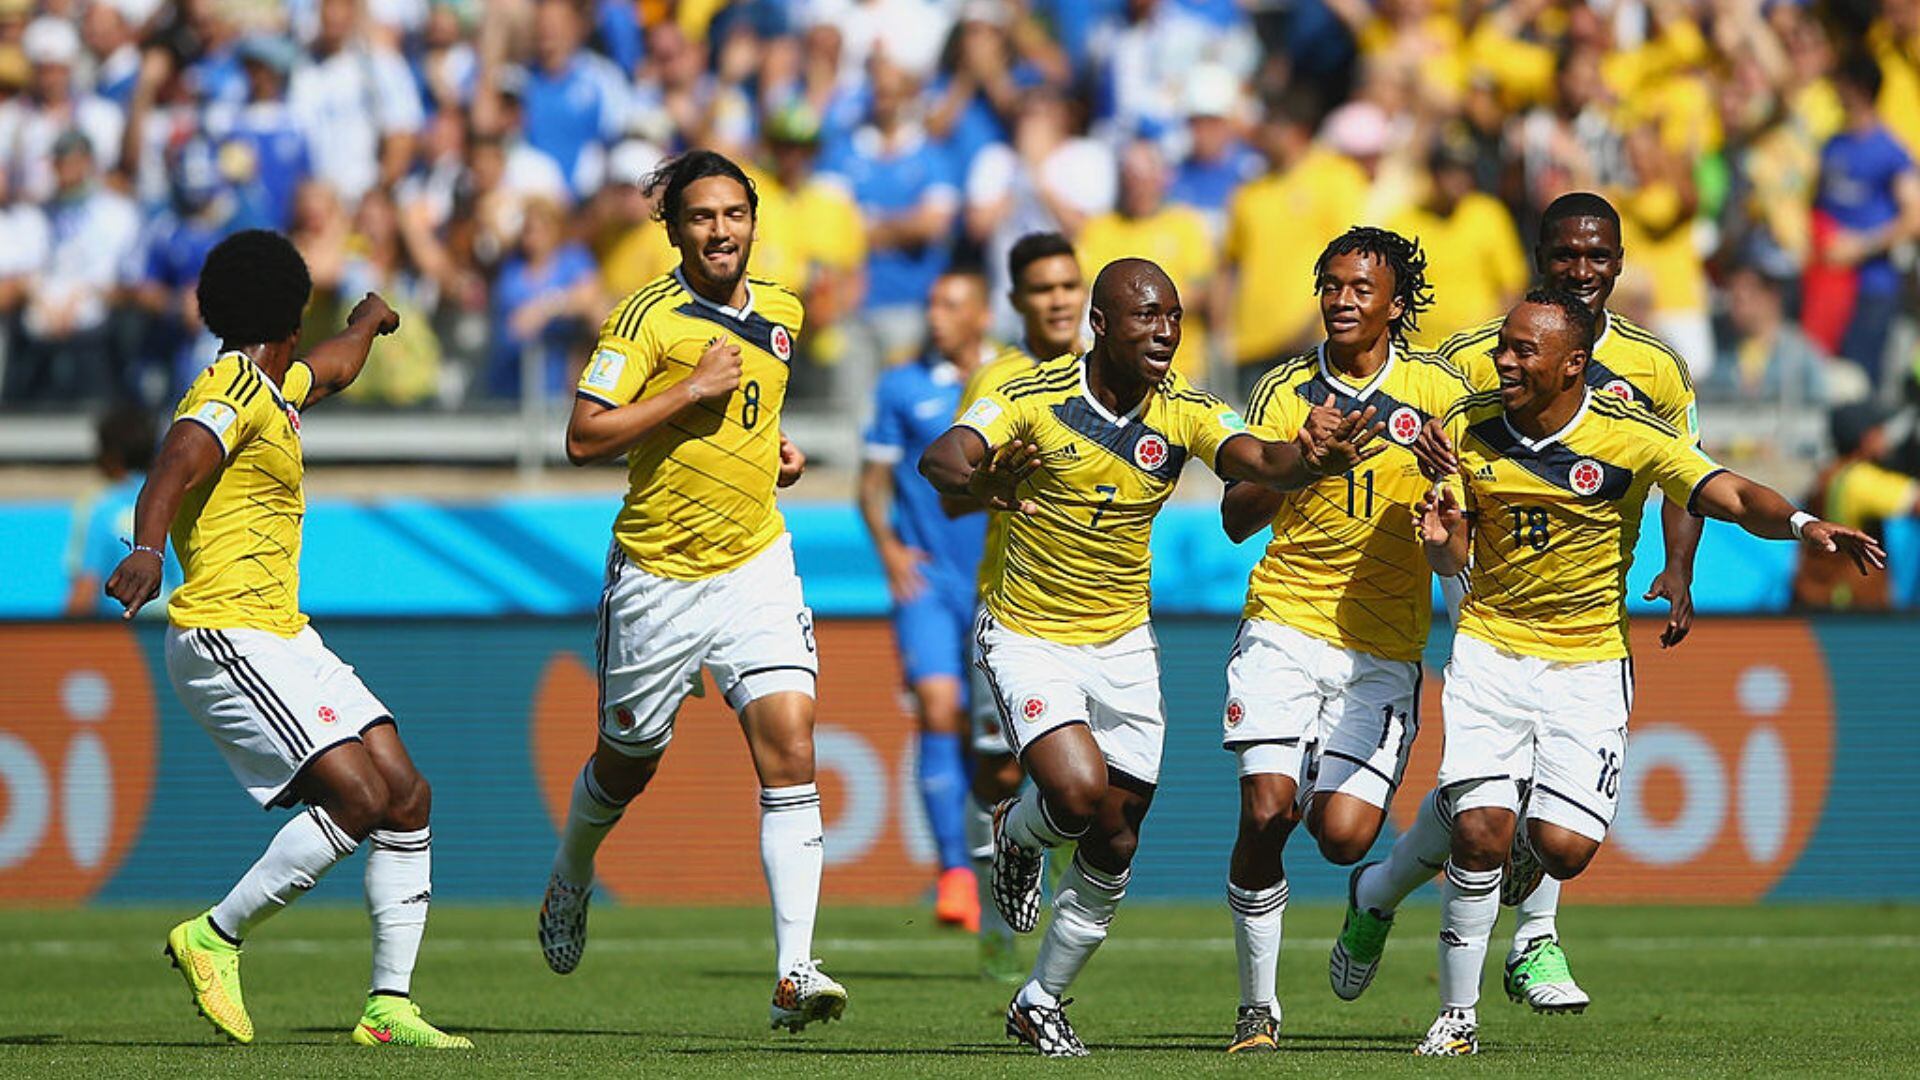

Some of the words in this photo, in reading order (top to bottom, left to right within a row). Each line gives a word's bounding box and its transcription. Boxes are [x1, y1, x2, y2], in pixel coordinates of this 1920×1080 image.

[743, 380, 760, 429] 8
[1091, 485, 1117, 528] 7
[1345, 469, 1374, 518] 11
[1509, 506, 1549, 550] 18
[1377, 704, 1407, 758] 11
[1596, 747, 1620, 800] 18
[1612, 665, 1792, 866] oi
